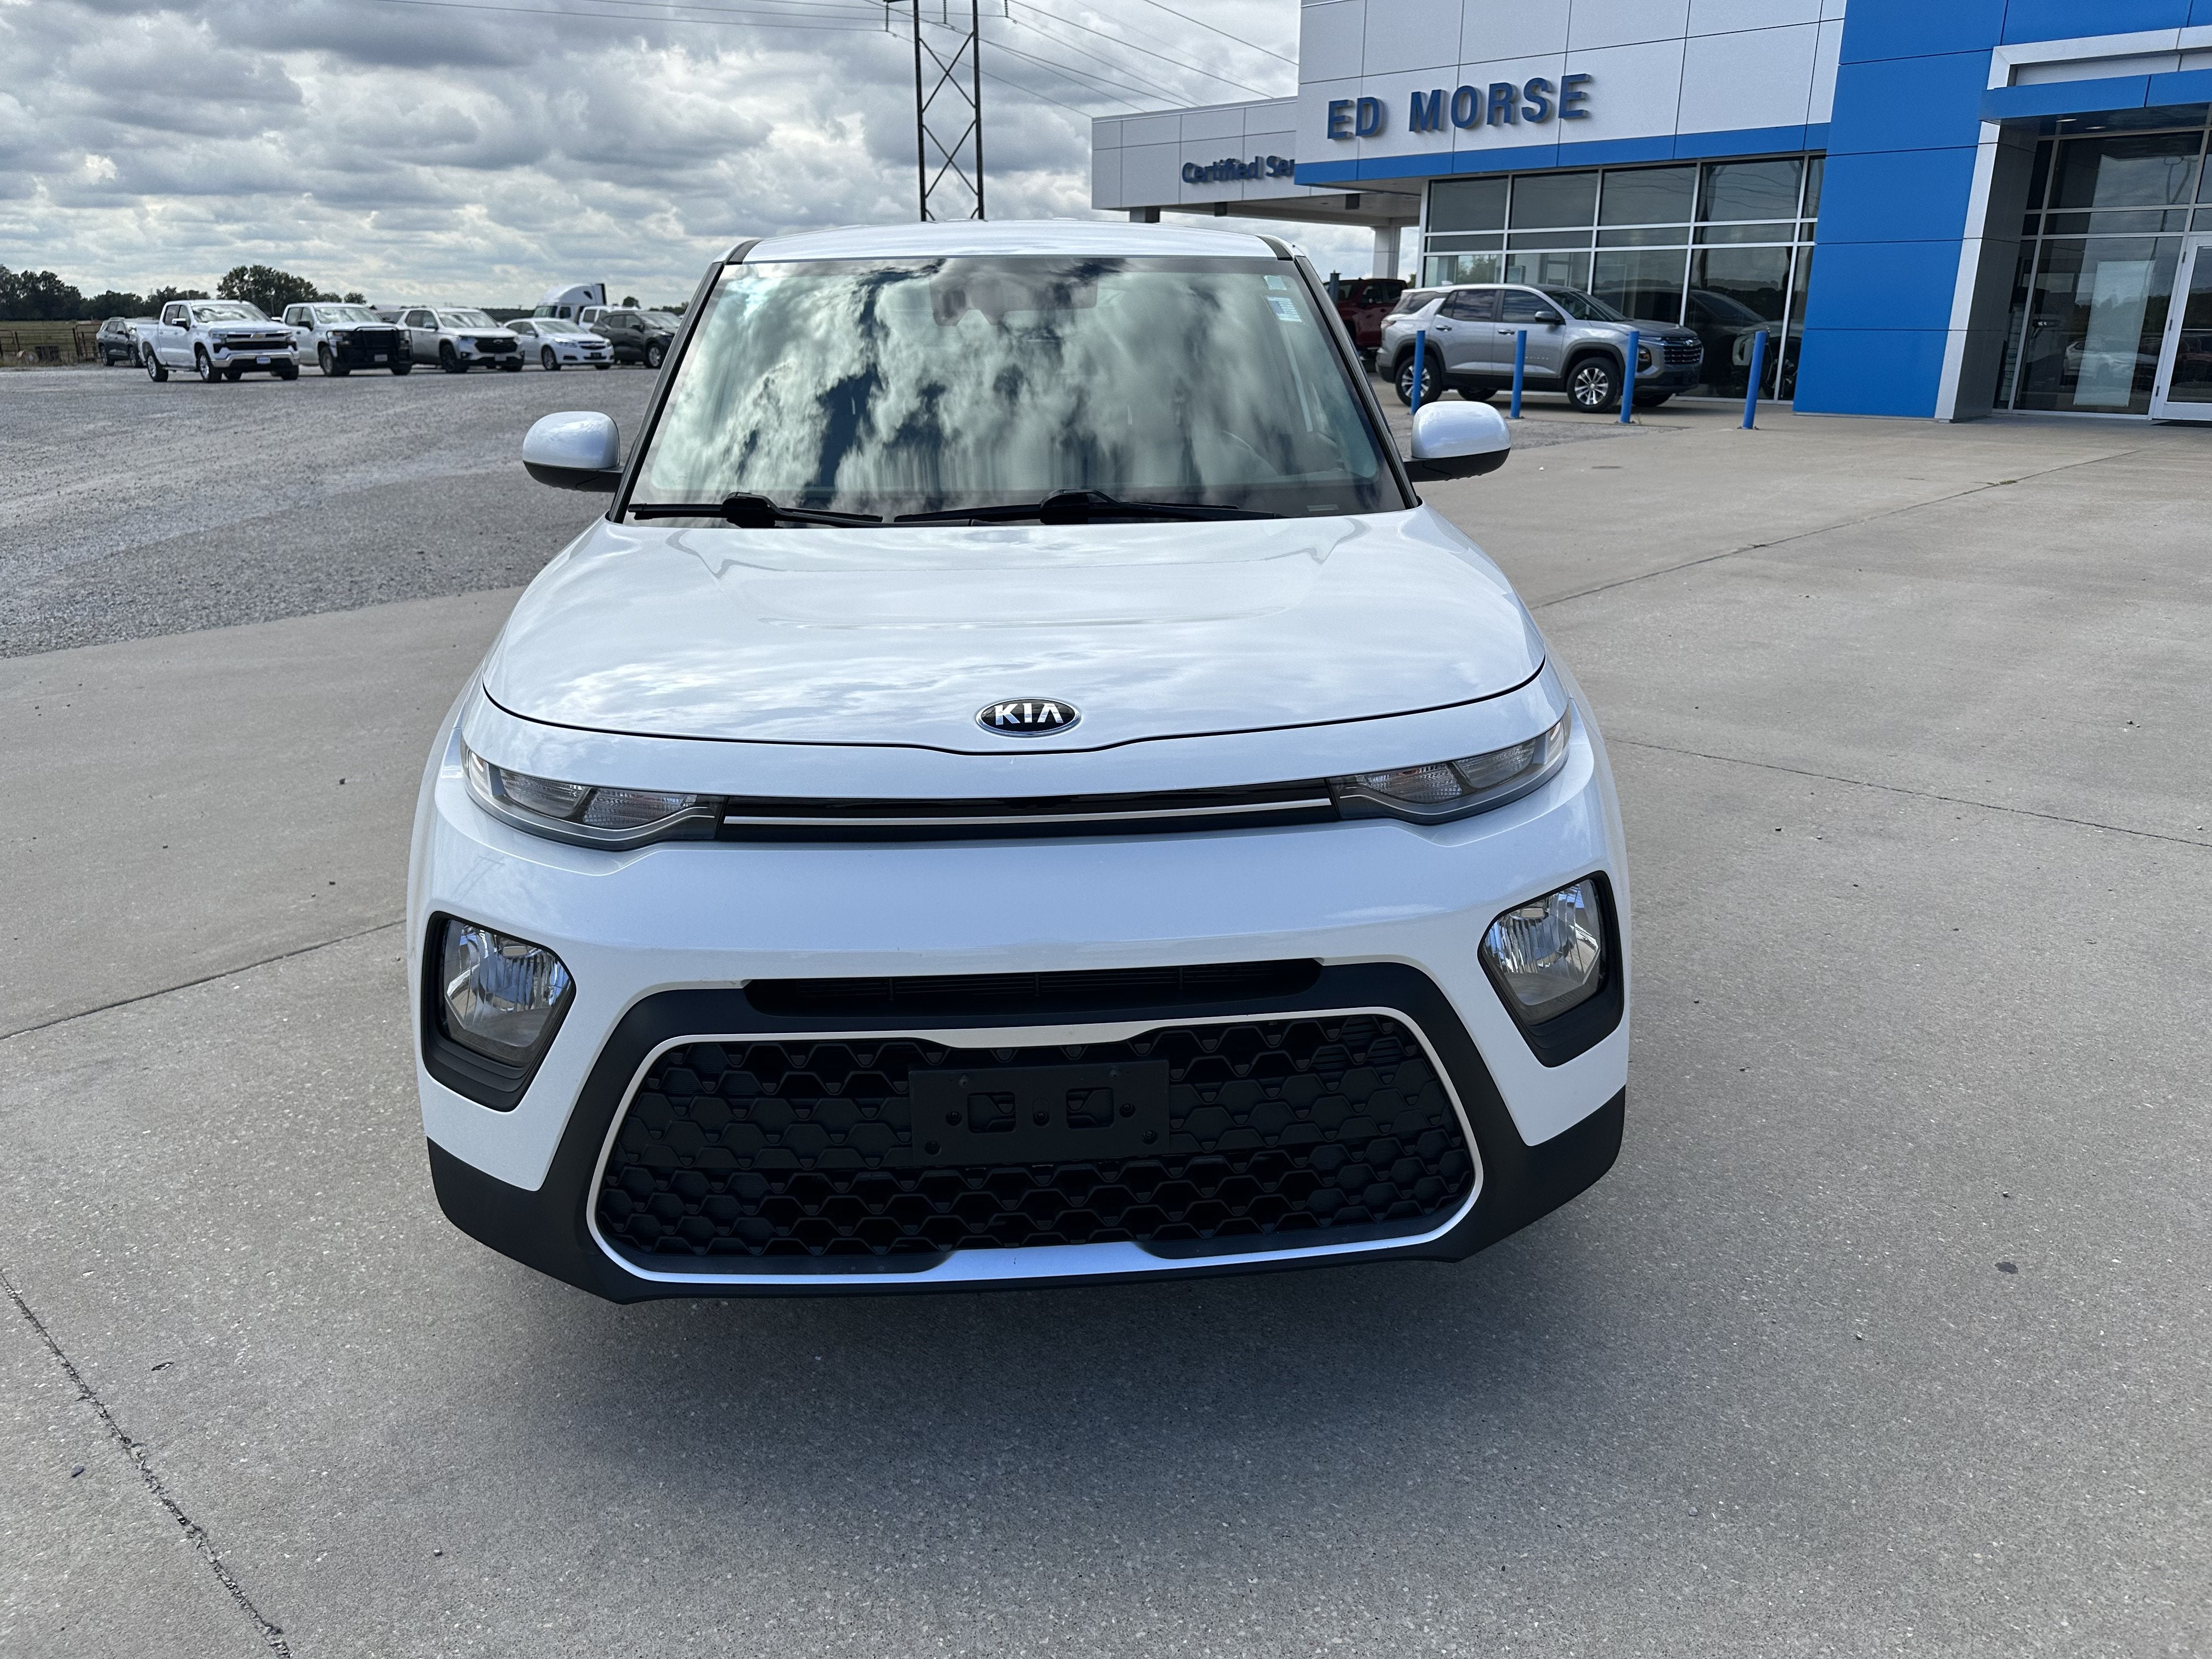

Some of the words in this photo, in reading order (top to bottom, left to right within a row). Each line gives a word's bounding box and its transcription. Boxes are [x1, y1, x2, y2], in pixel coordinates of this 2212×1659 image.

[1327, 96, 1385, 139] ED
[1409, 73, 1591, 132] MORSE
[1182, 156, 1263, 183] Certified
[994, 703, 1064, 725] KIA
